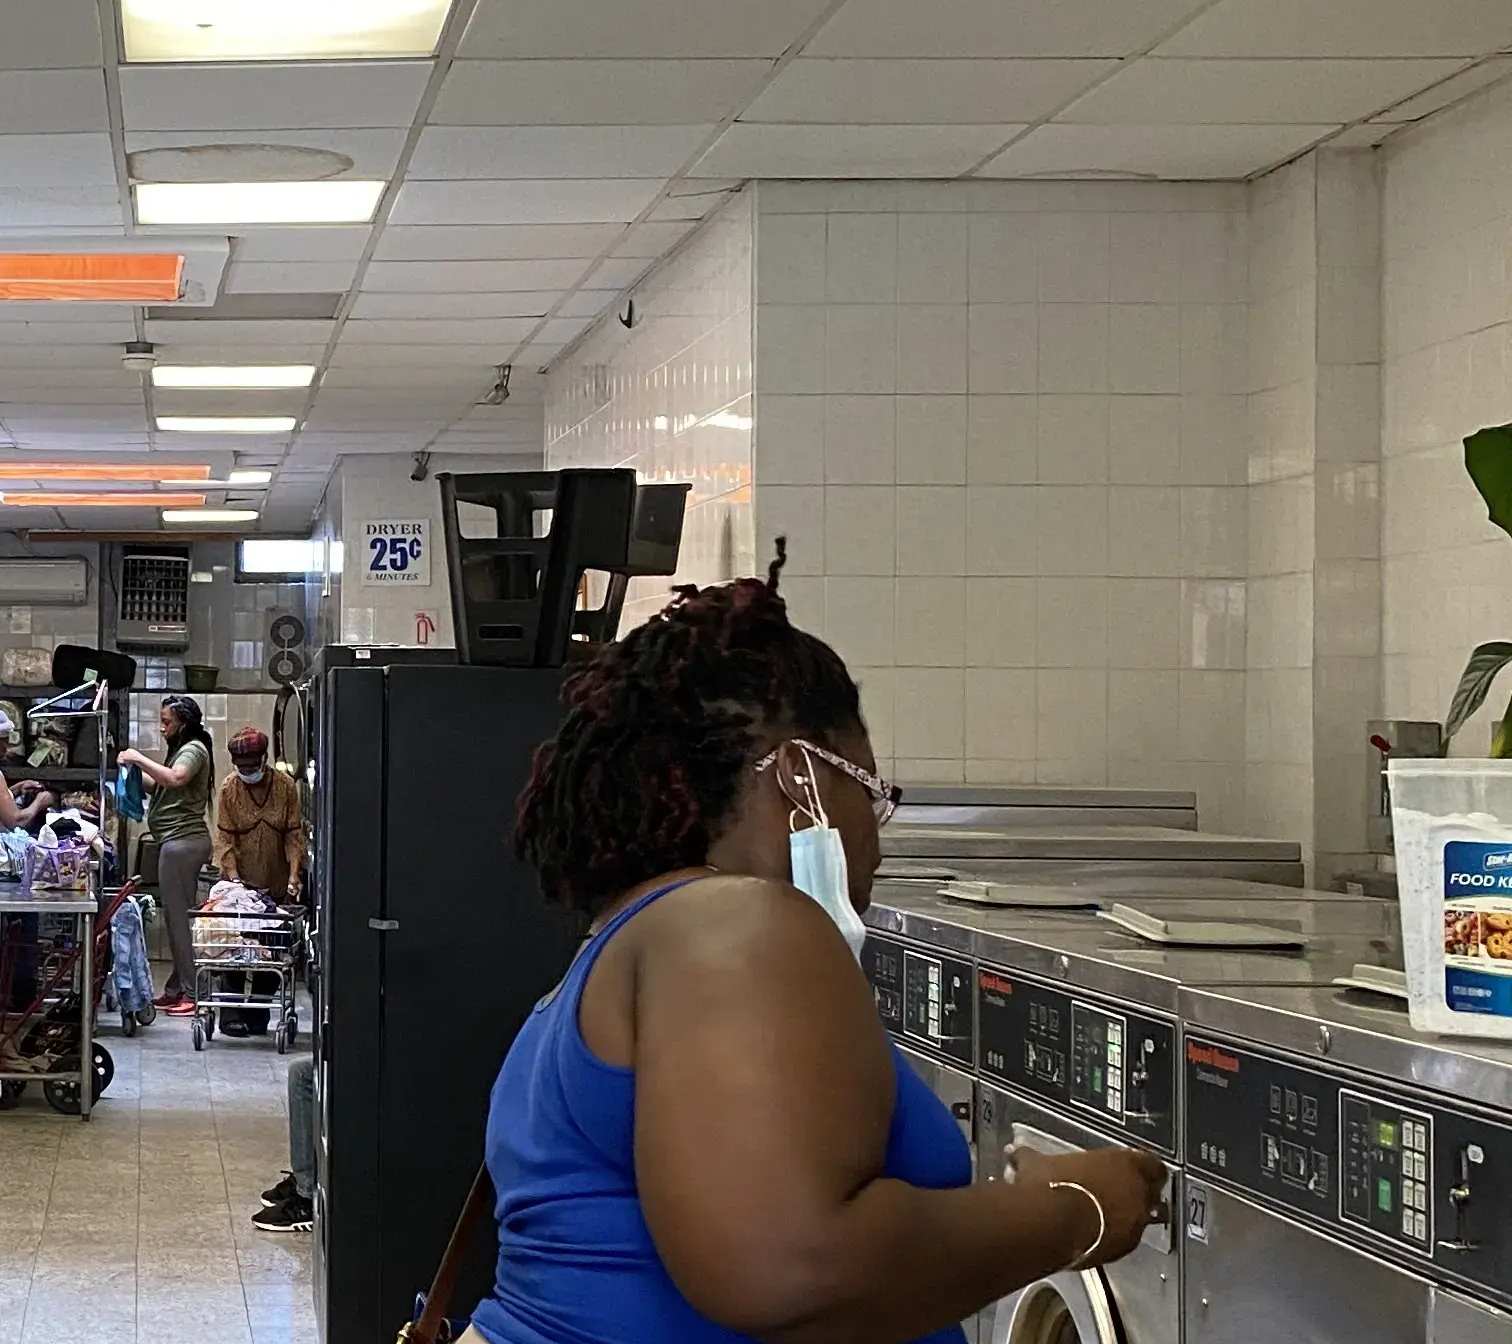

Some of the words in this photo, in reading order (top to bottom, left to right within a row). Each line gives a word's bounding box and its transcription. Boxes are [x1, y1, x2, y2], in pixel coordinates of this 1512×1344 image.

[366, 523, 423, 535] DRYER
[369, 537, 422, 571] 25¢
[375, 572, 419, 581] MINUTES
[1449, 873, 1496, 887] FOOD
[1190, 1197, 1205, 1229] 27
